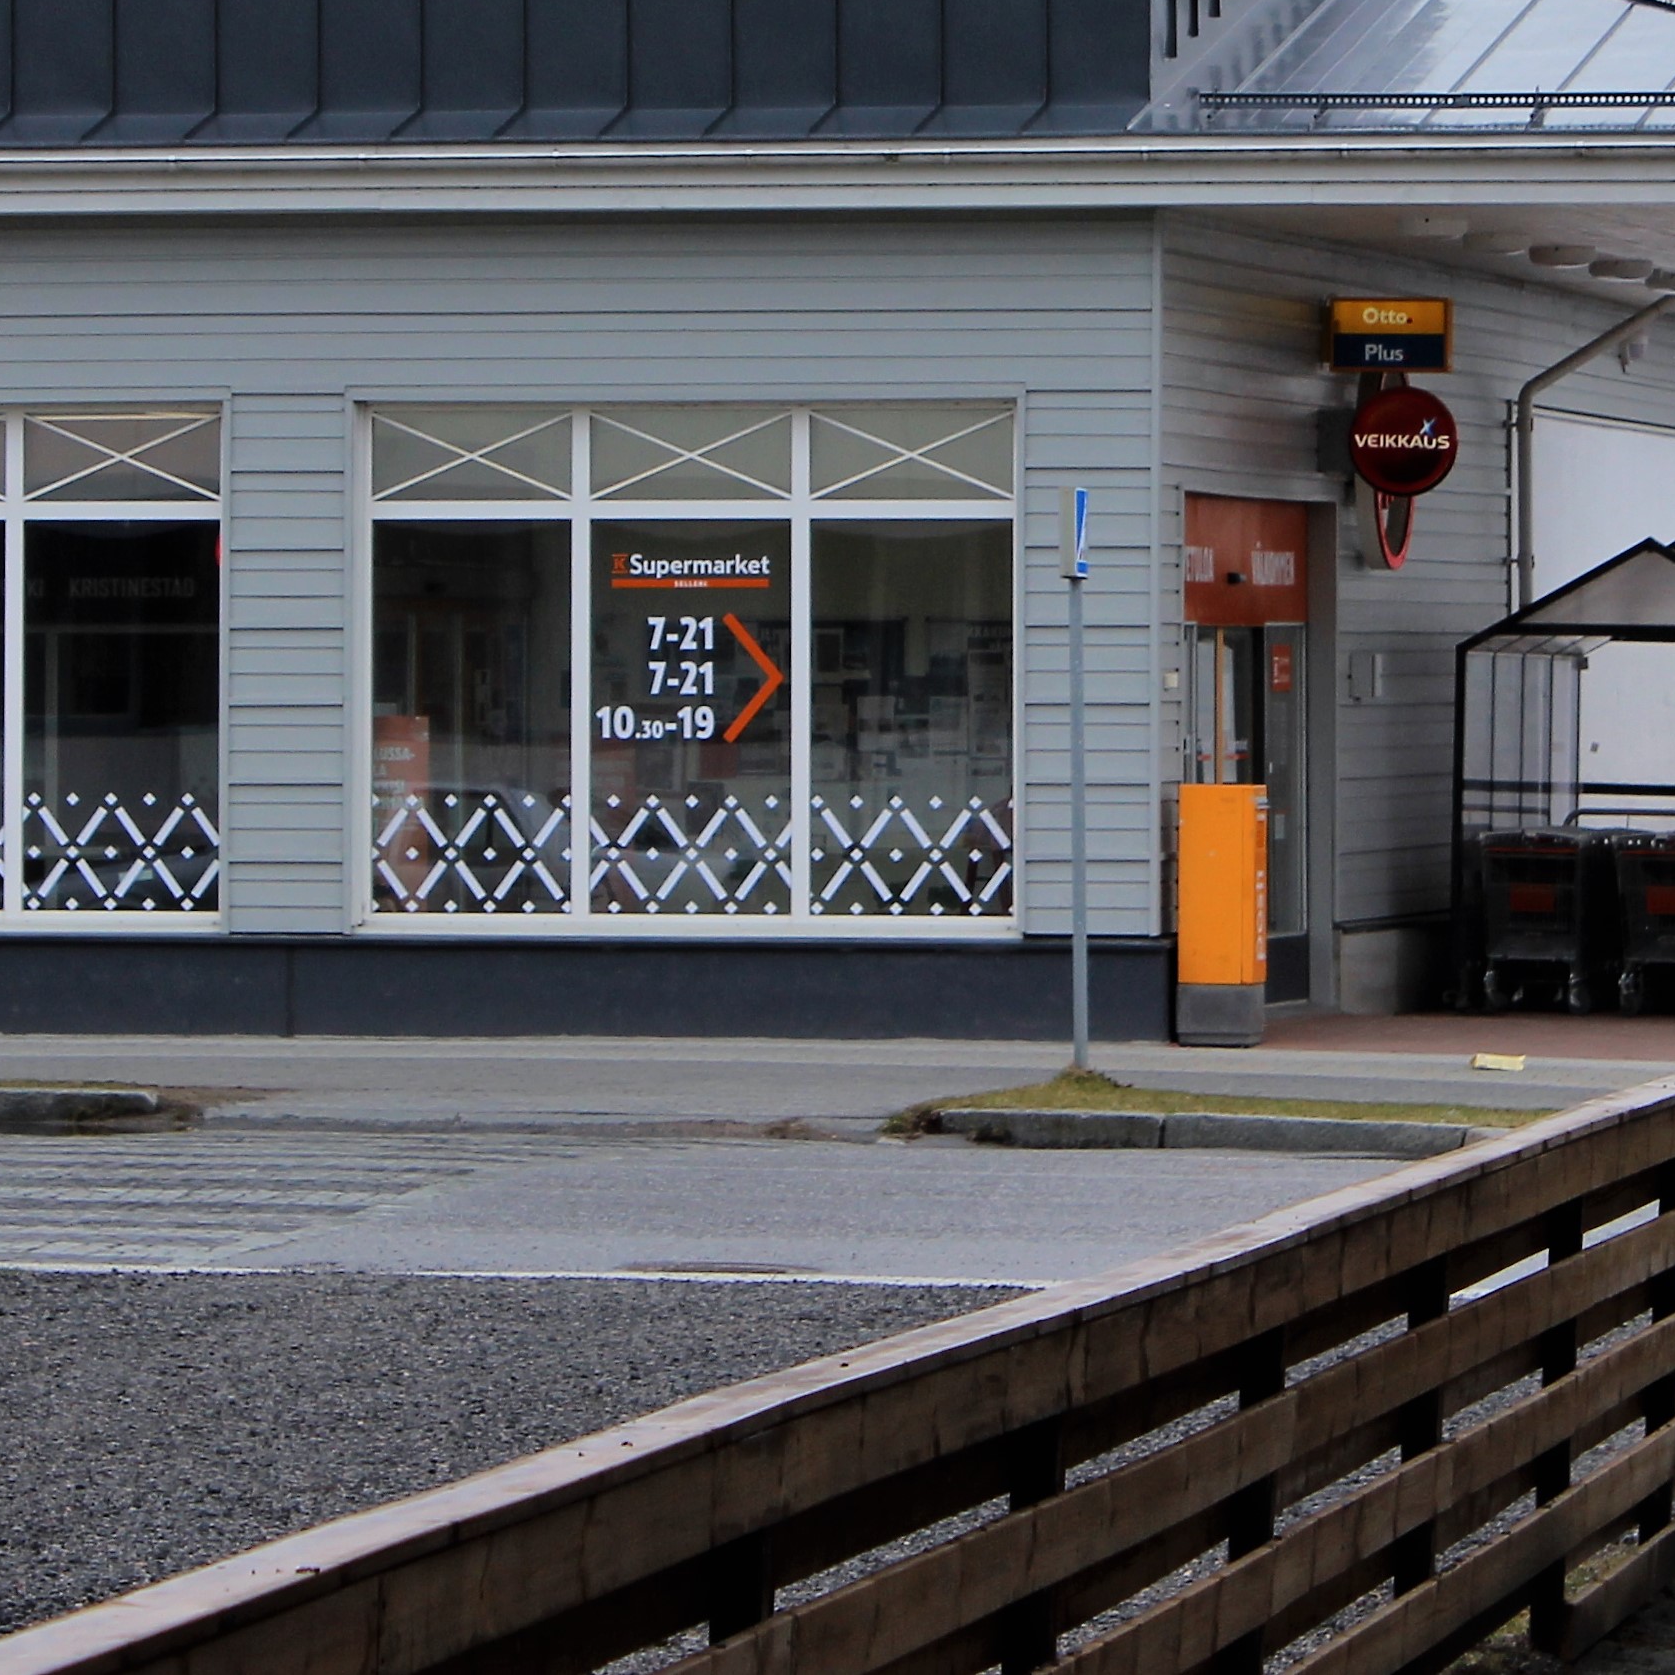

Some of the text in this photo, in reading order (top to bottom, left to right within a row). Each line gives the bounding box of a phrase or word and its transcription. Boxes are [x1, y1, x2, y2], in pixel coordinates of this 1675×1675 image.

[1365, 344, 1404, 361] Plus
[1354, 434, 1451, 449] VEIKKAUS
[629, 553, 770, 578] Supermarket
[648, 617, 714, 651] 7-21
[648, 661, 714, 695] 7-21
[595, 705, 715, 740] 10.30-19
